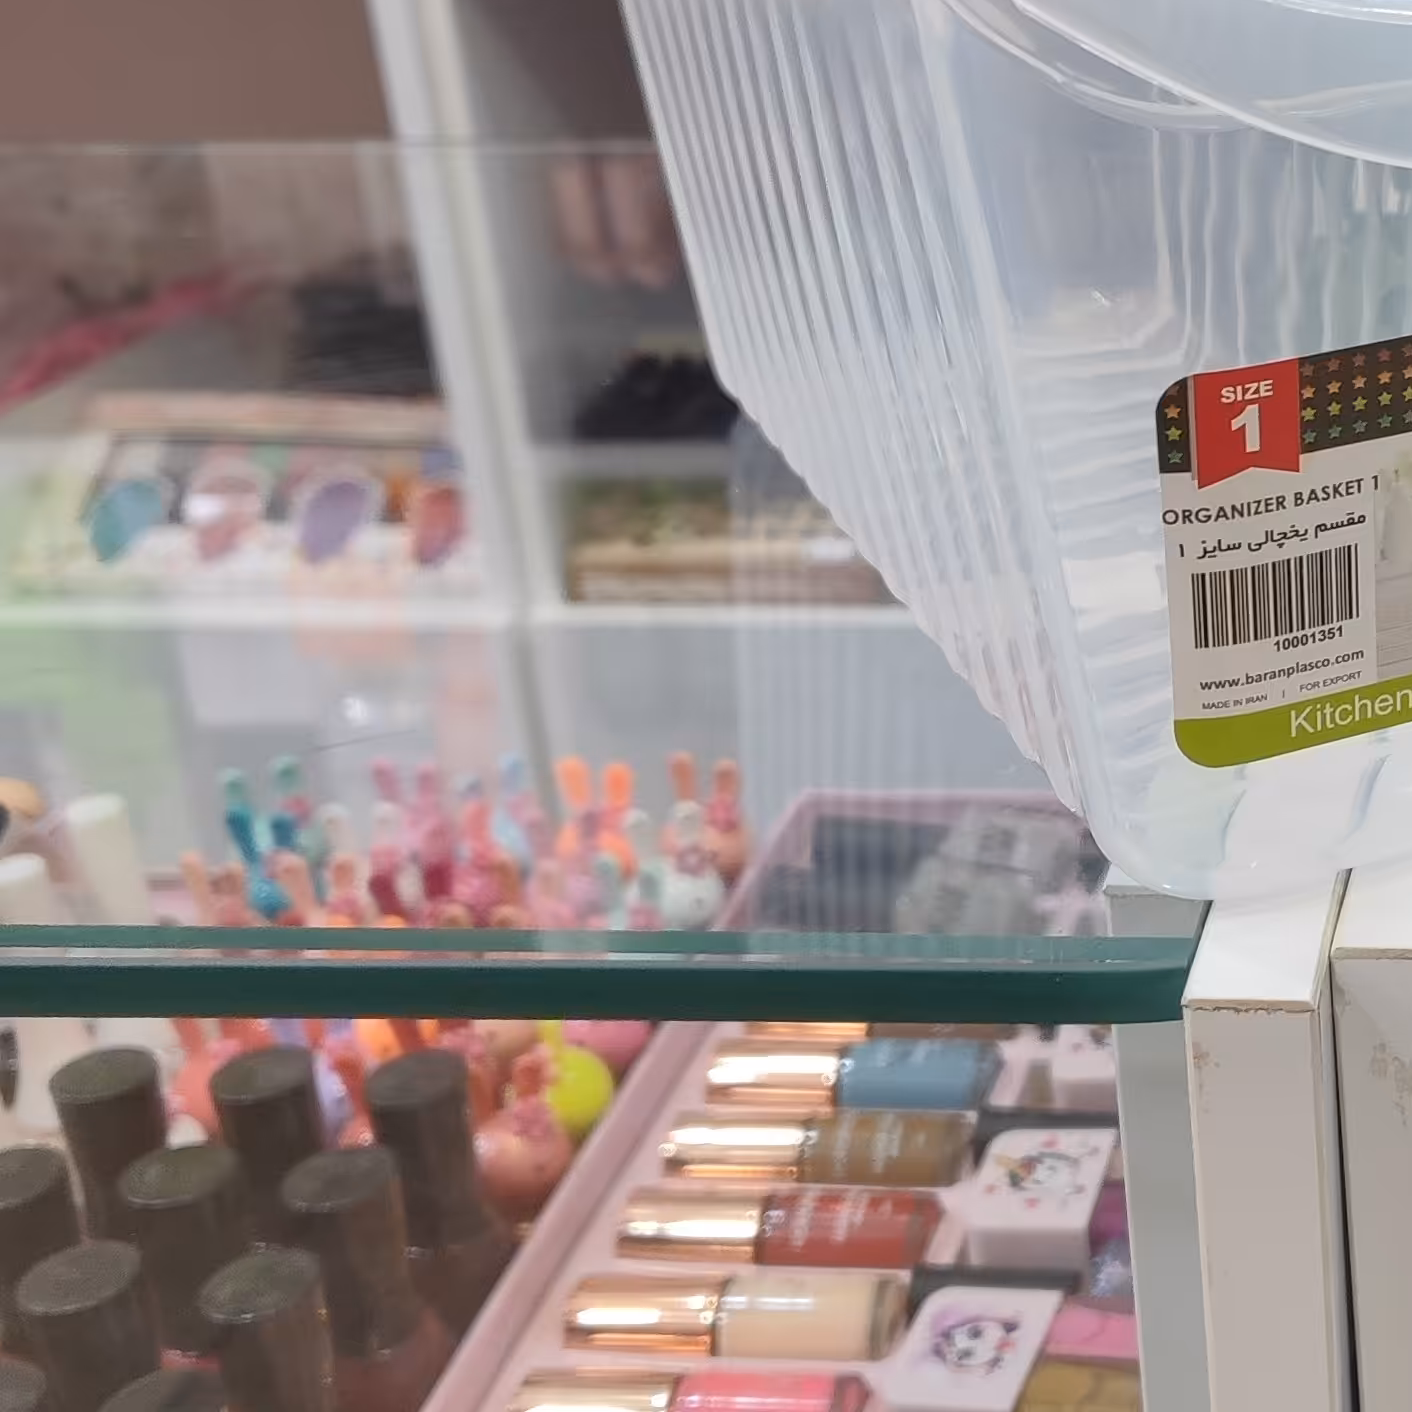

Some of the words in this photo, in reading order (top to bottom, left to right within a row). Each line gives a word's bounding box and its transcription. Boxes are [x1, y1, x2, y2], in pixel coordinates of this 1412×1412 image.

[1220, 380, 1274, 403] SIZE
[1231, 403, 1261, 453] 1
[1162, 495, 1287, 525] ORGANIZER
[1294, 478, 1364, 507] BASKET
[1371, 475, 1380, 491] 1
[1314, 512, 1366, 538] مقسم
[1197, 538, 1242, 559] سایز
[1273, 625, 1344, 652] 10001351
[1199, 649, 1365, 691] www.baranplasco.com
[1299, 680, 1321, 693] FOR
[1323, 670, 1362, 687] EXPORT
[1202, 699, 1231, 710] MADE
[1233, 697, 1243, 707] IN
[1245, 693, 1268, 705] IRAN
